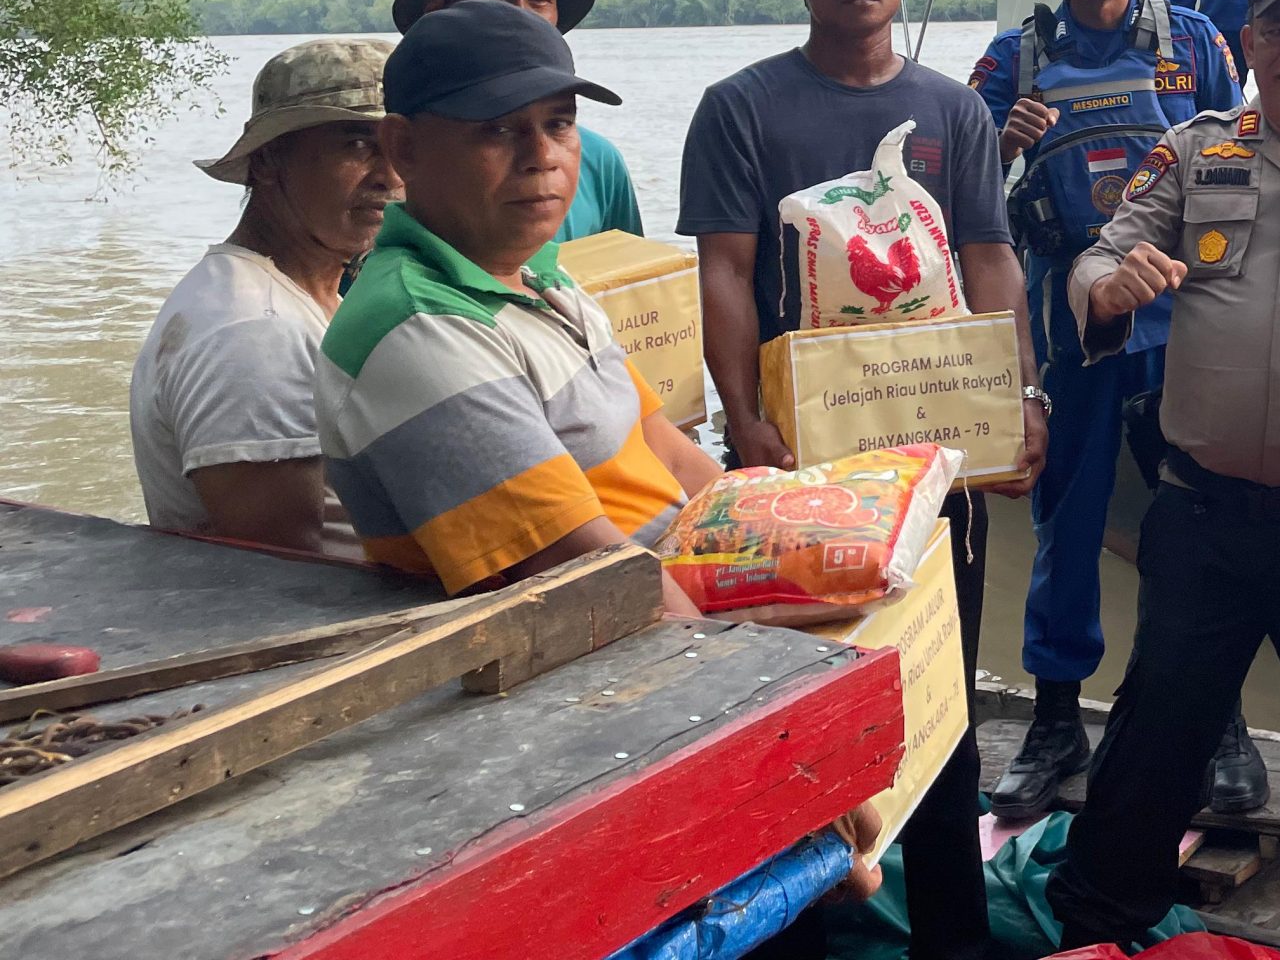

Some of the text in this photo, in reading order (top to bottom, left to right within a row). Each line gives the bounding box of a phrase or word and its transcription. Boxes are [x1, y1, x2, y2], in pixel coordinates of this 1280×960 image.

[1155, 75, 1193, 91] OLRI
[1072, 95, 1129, 111] MESDIANTO
[910, 199, 934, 232] LEZAT
[617, 311, 659, 333] JALUR
[645, 320, 696, 349] Rakyat)
[862, 353, 973, 377] PROGRAM JALUR
[658, 378, 674, 395] 79
[823, 369, 1012, 410] (Jelajah Riau Untuk Rakyat)
[916, 406, 927, 419] &
[858, 426, 961, 452] BHAYANGKARA
[974, 422, 990, 437] 79
[897, 588, 945, 659] ROGRAM JALUR
